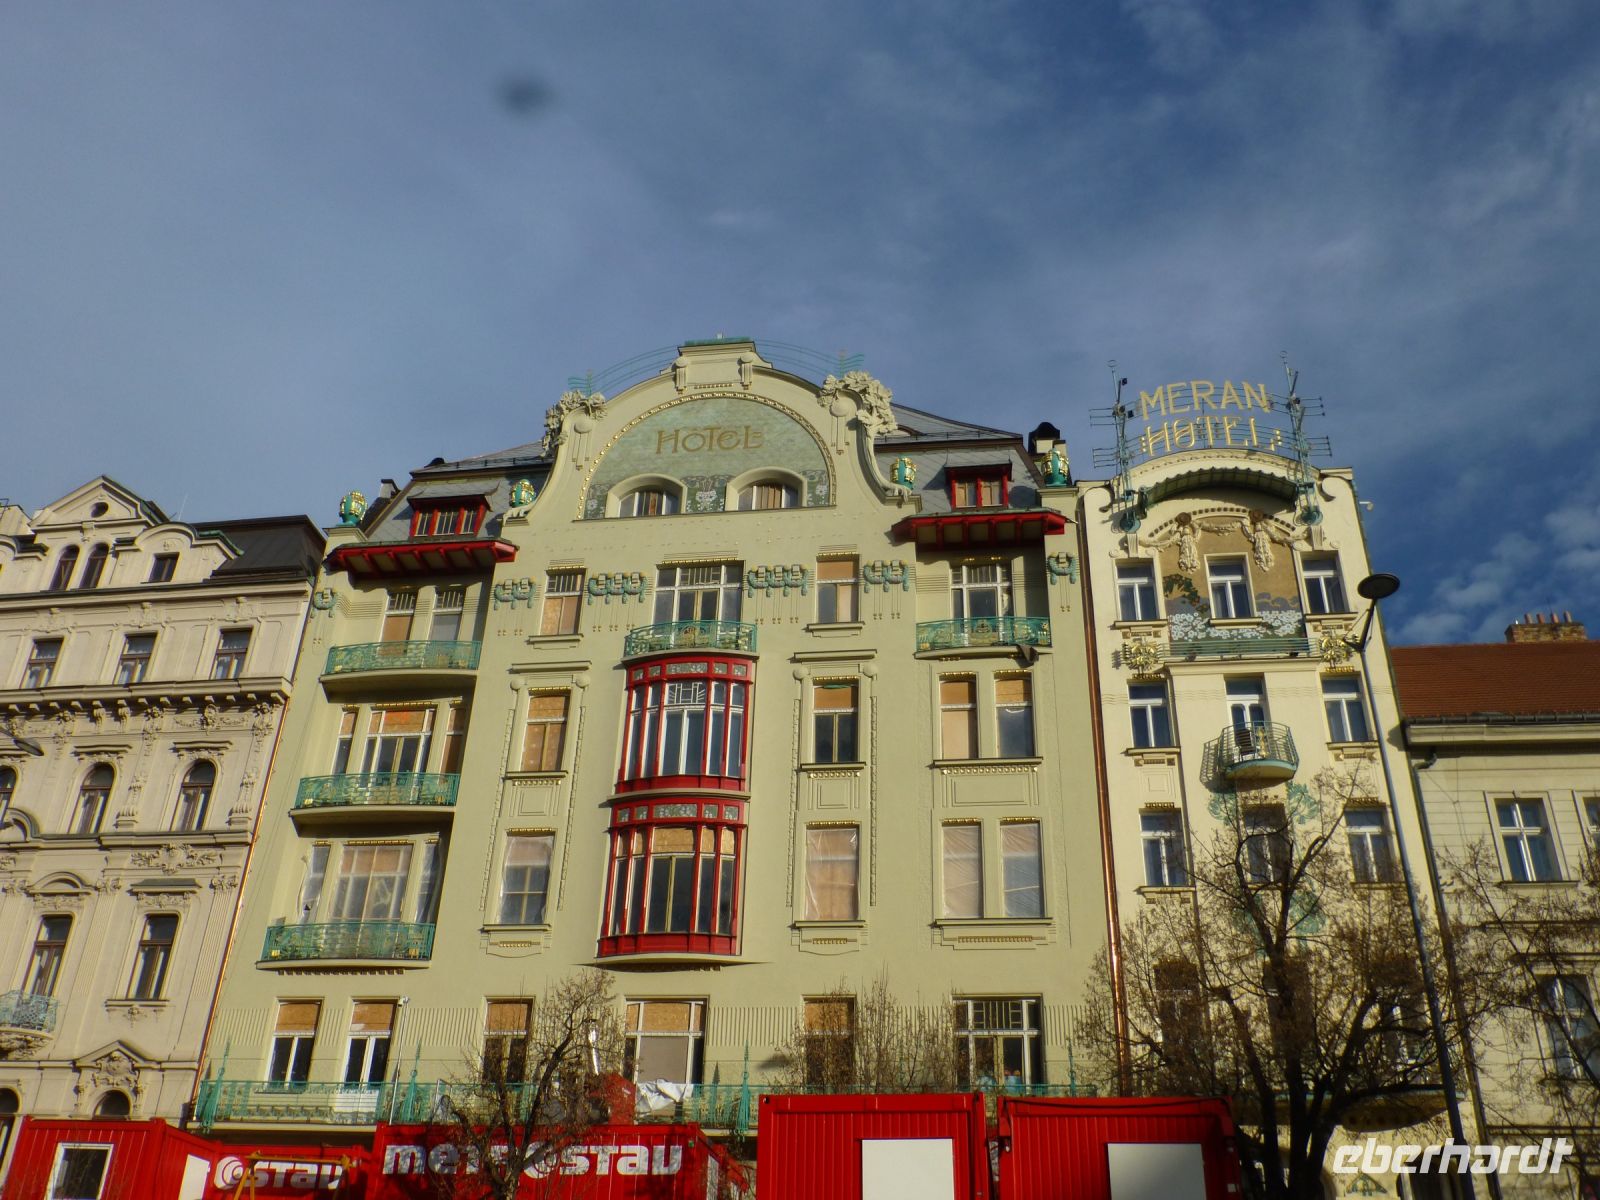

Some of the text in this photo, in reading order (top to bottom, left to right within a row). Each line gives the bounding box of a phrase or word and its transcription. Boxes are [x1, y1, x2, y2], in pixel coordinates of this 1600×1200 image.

[1140, 380, 1271, 421] MERAN
[655, 425, 763, 455] HOTEL
[1146, 416, 1276, 456] HOTEL
